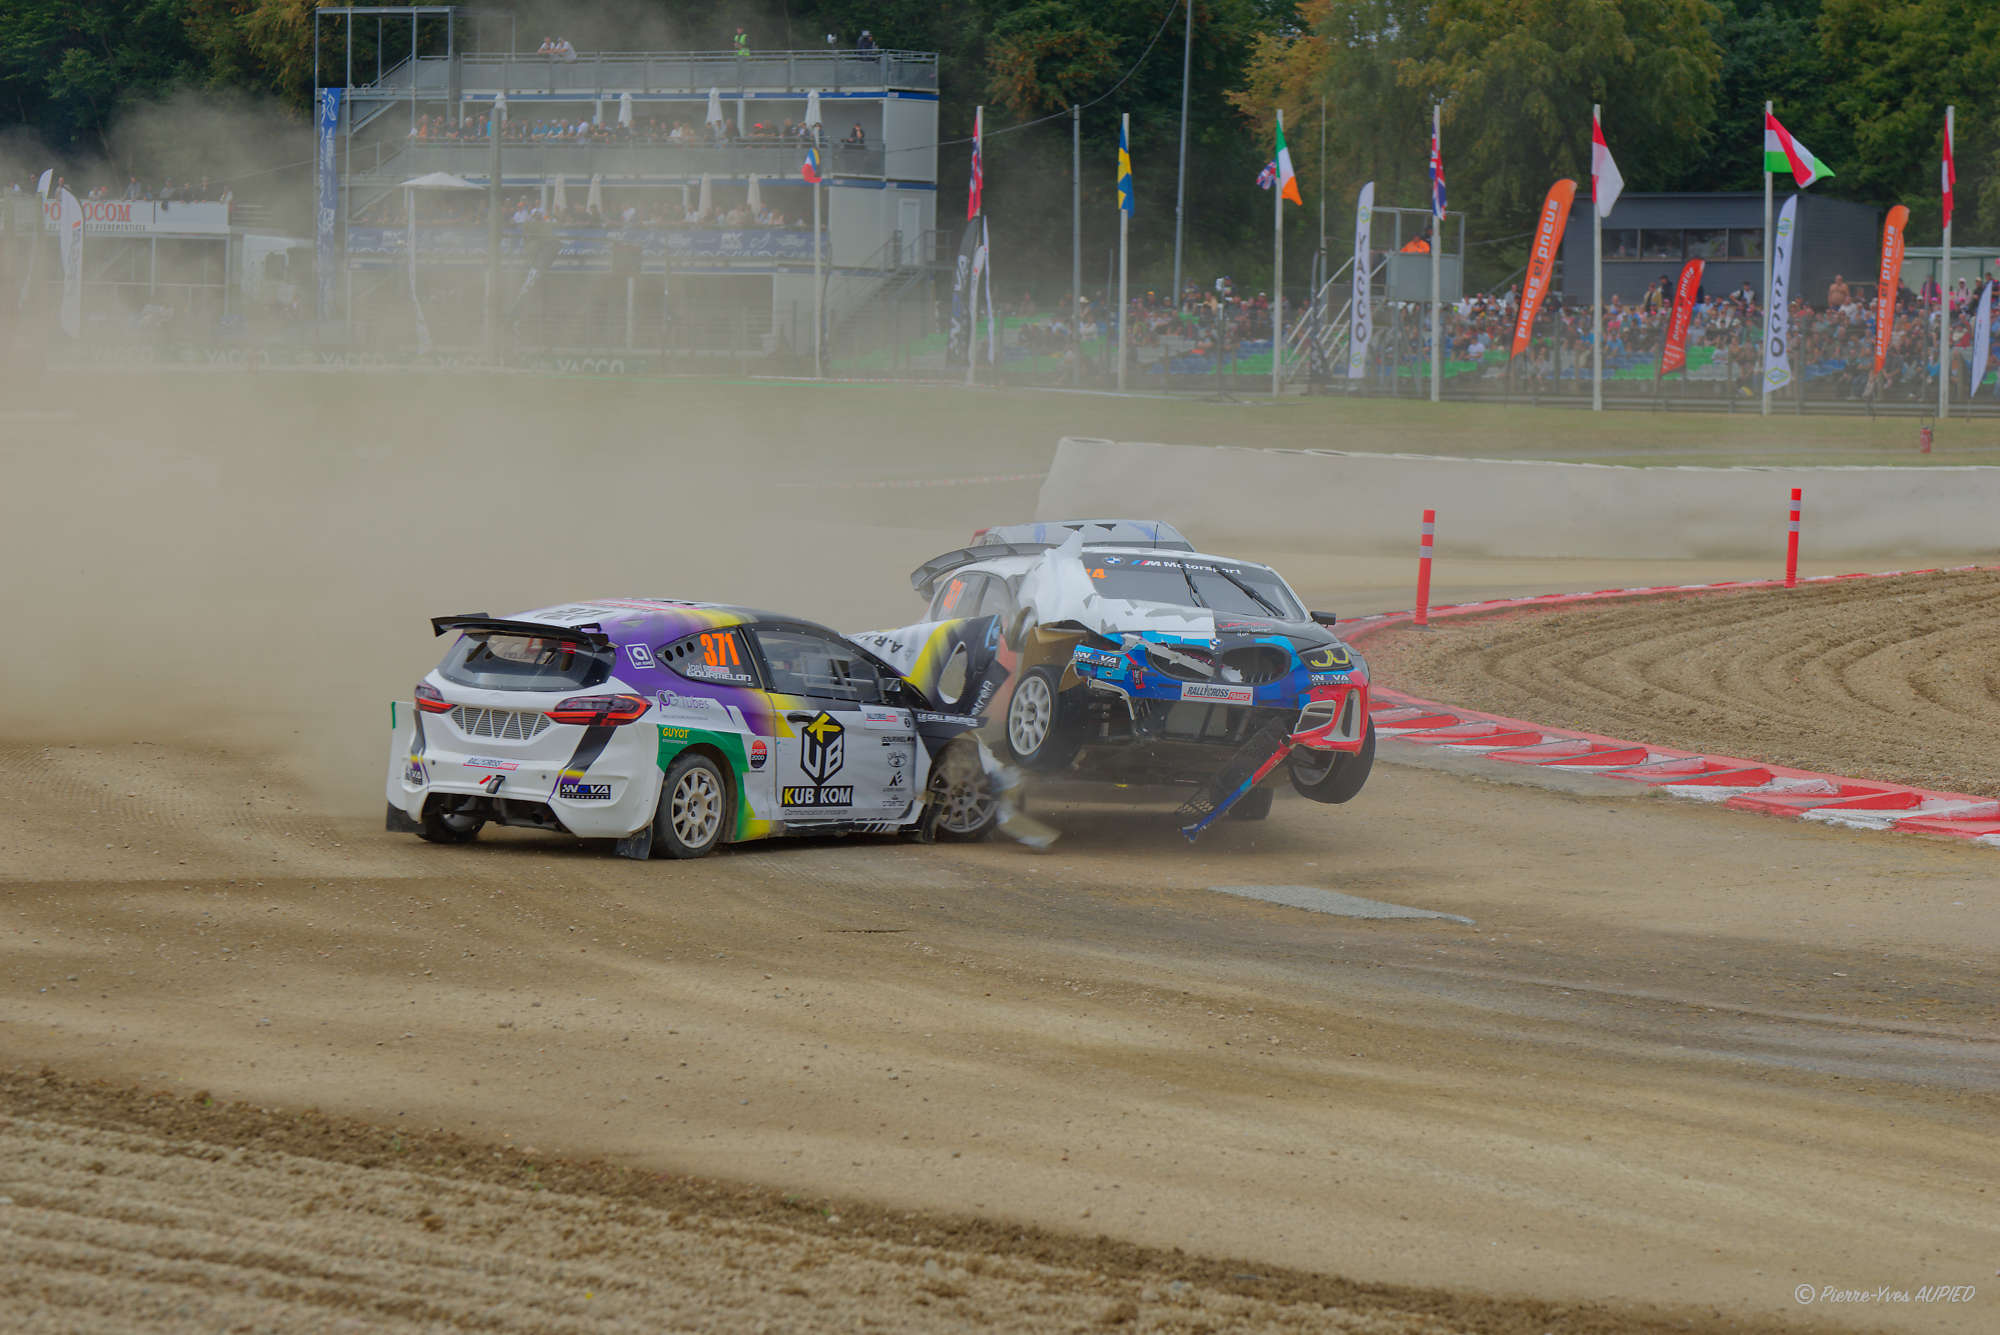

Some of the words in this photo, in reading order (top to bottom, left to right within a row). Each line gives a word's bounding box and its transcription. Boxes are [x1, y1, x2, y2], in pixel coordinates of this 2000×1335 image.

[1356, 232, 1367, 344] YACCO
[1086, 568, 1108, 579] 4
[700, 632, 741, 667] 371
[686, 669, 752, 682] GOURMELON
[1187, 686, 1229, 698] RALLYCROSS
[662, 727, 690, 739] GUYOT
[564, 784, 609, 794] NOVA
[784, 788, 815, 804] KUB
[820, 788, 851, 804] KOM
